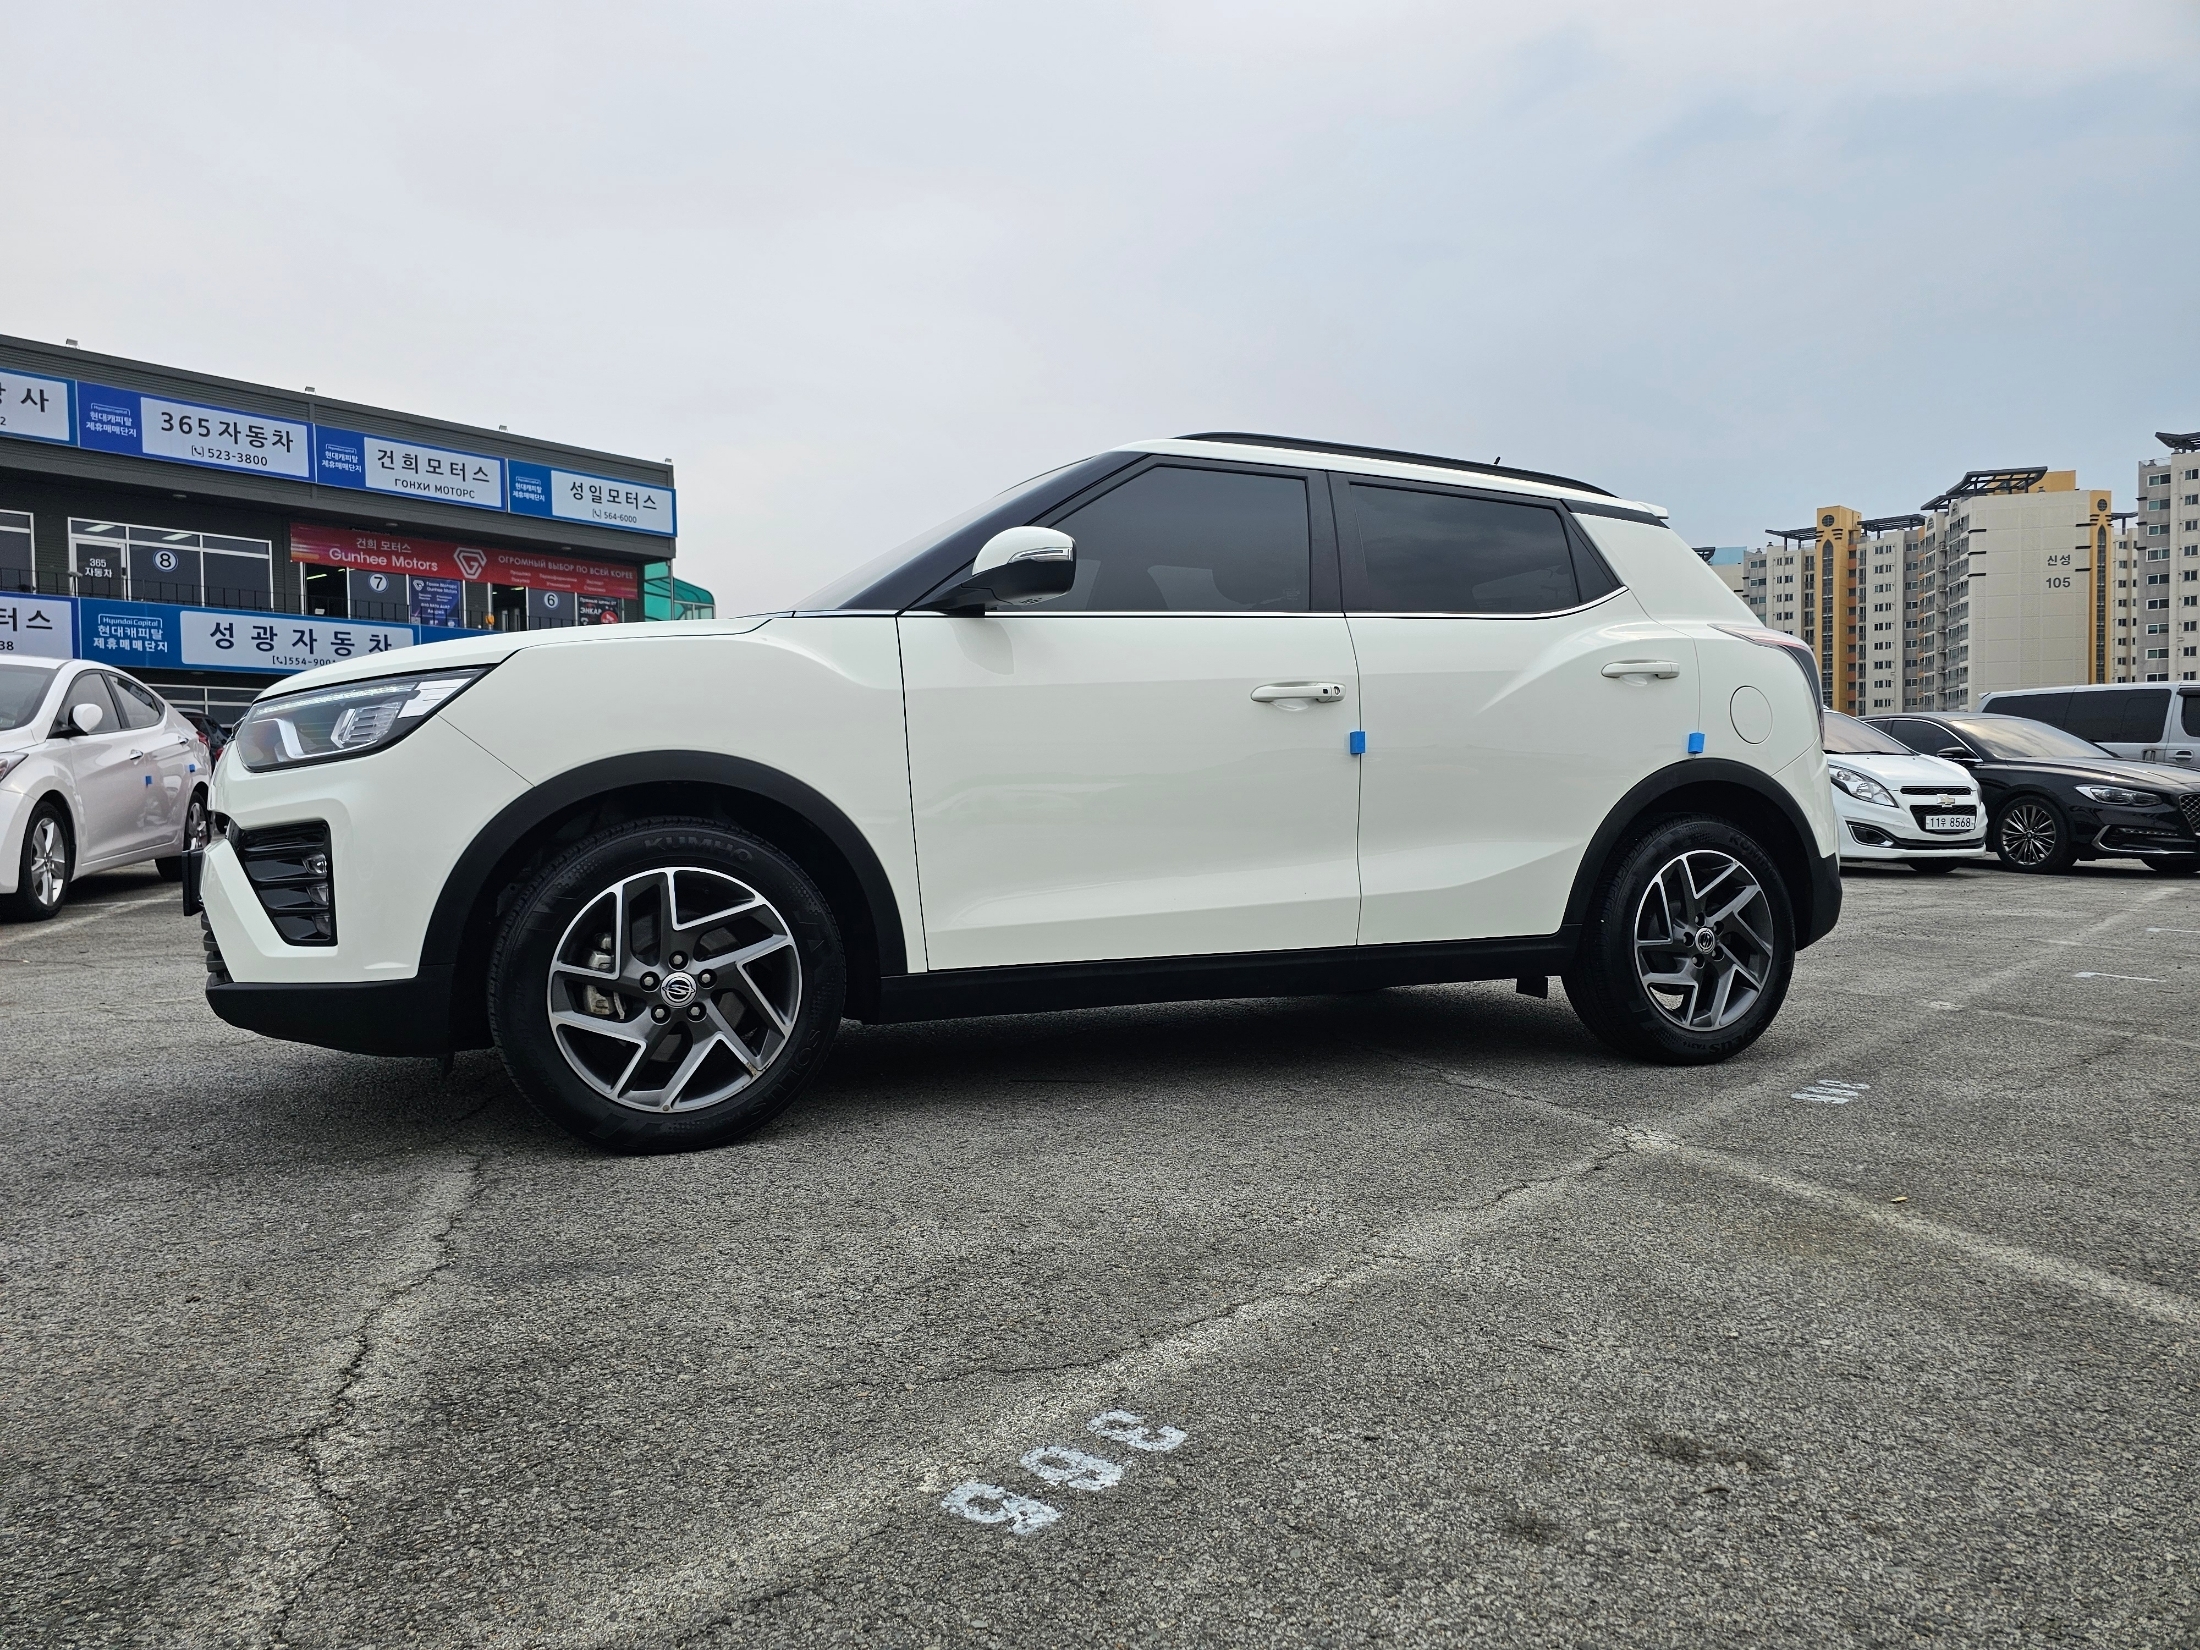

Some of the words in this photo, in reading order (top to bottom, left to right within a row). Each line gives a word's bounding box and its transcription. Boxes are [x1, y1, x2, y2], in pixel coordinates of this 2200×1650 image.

[0, 382, 50, 413] 사
[207, 448, 268, 466] 523-3800
[377, 449, 490, 483] 건희모터스
[394, 478, 431, 492] ГОНХИ
[434, 484, 476, 499] МОТОРС
[570, 481, 657, 510] 성일모터스
[603, 511, 638, 524] 564-6000
[356, 537, 377, 550] 건희
[381, 540, 412, 553] 모터스
[89, 558, 107, 568] 365
[160, 552, 171, 568] 8
[329, 547, 387, 566] Gunhee
[391, 554, 438, 571] Motors
[498, 555, 546, 568] ОГРОМНЫЙ
[548, 561, 575, 572] ВЫБОР
[576, 565, 588, 573] ПО
[590, 566, 609, 576] ВСЕЙ
[610, 569, 633, 579] КОРЕЕ
[2047, 554, 2071, 566] 신성
[84, 567, 112, 578] 자동차
[373, 576, 383, 590] 7
[2045, 577, 2071, 589] 105
[546, 593, 557, 607] 6
[580, 607, 602, 615] ЭНКАР
[103, 616, 133, 626] Hyundai
[133, 619, 159, 627] Capital
[98, 625, 164, 641] 현대캐피탈
[210, 621, 393, 657] 성광자동차
[93, 637, 168, 653] 제휴매매단지
[1950, 817, 1971, 828] 8568
[644, 834, 754, 864] KUMHO
